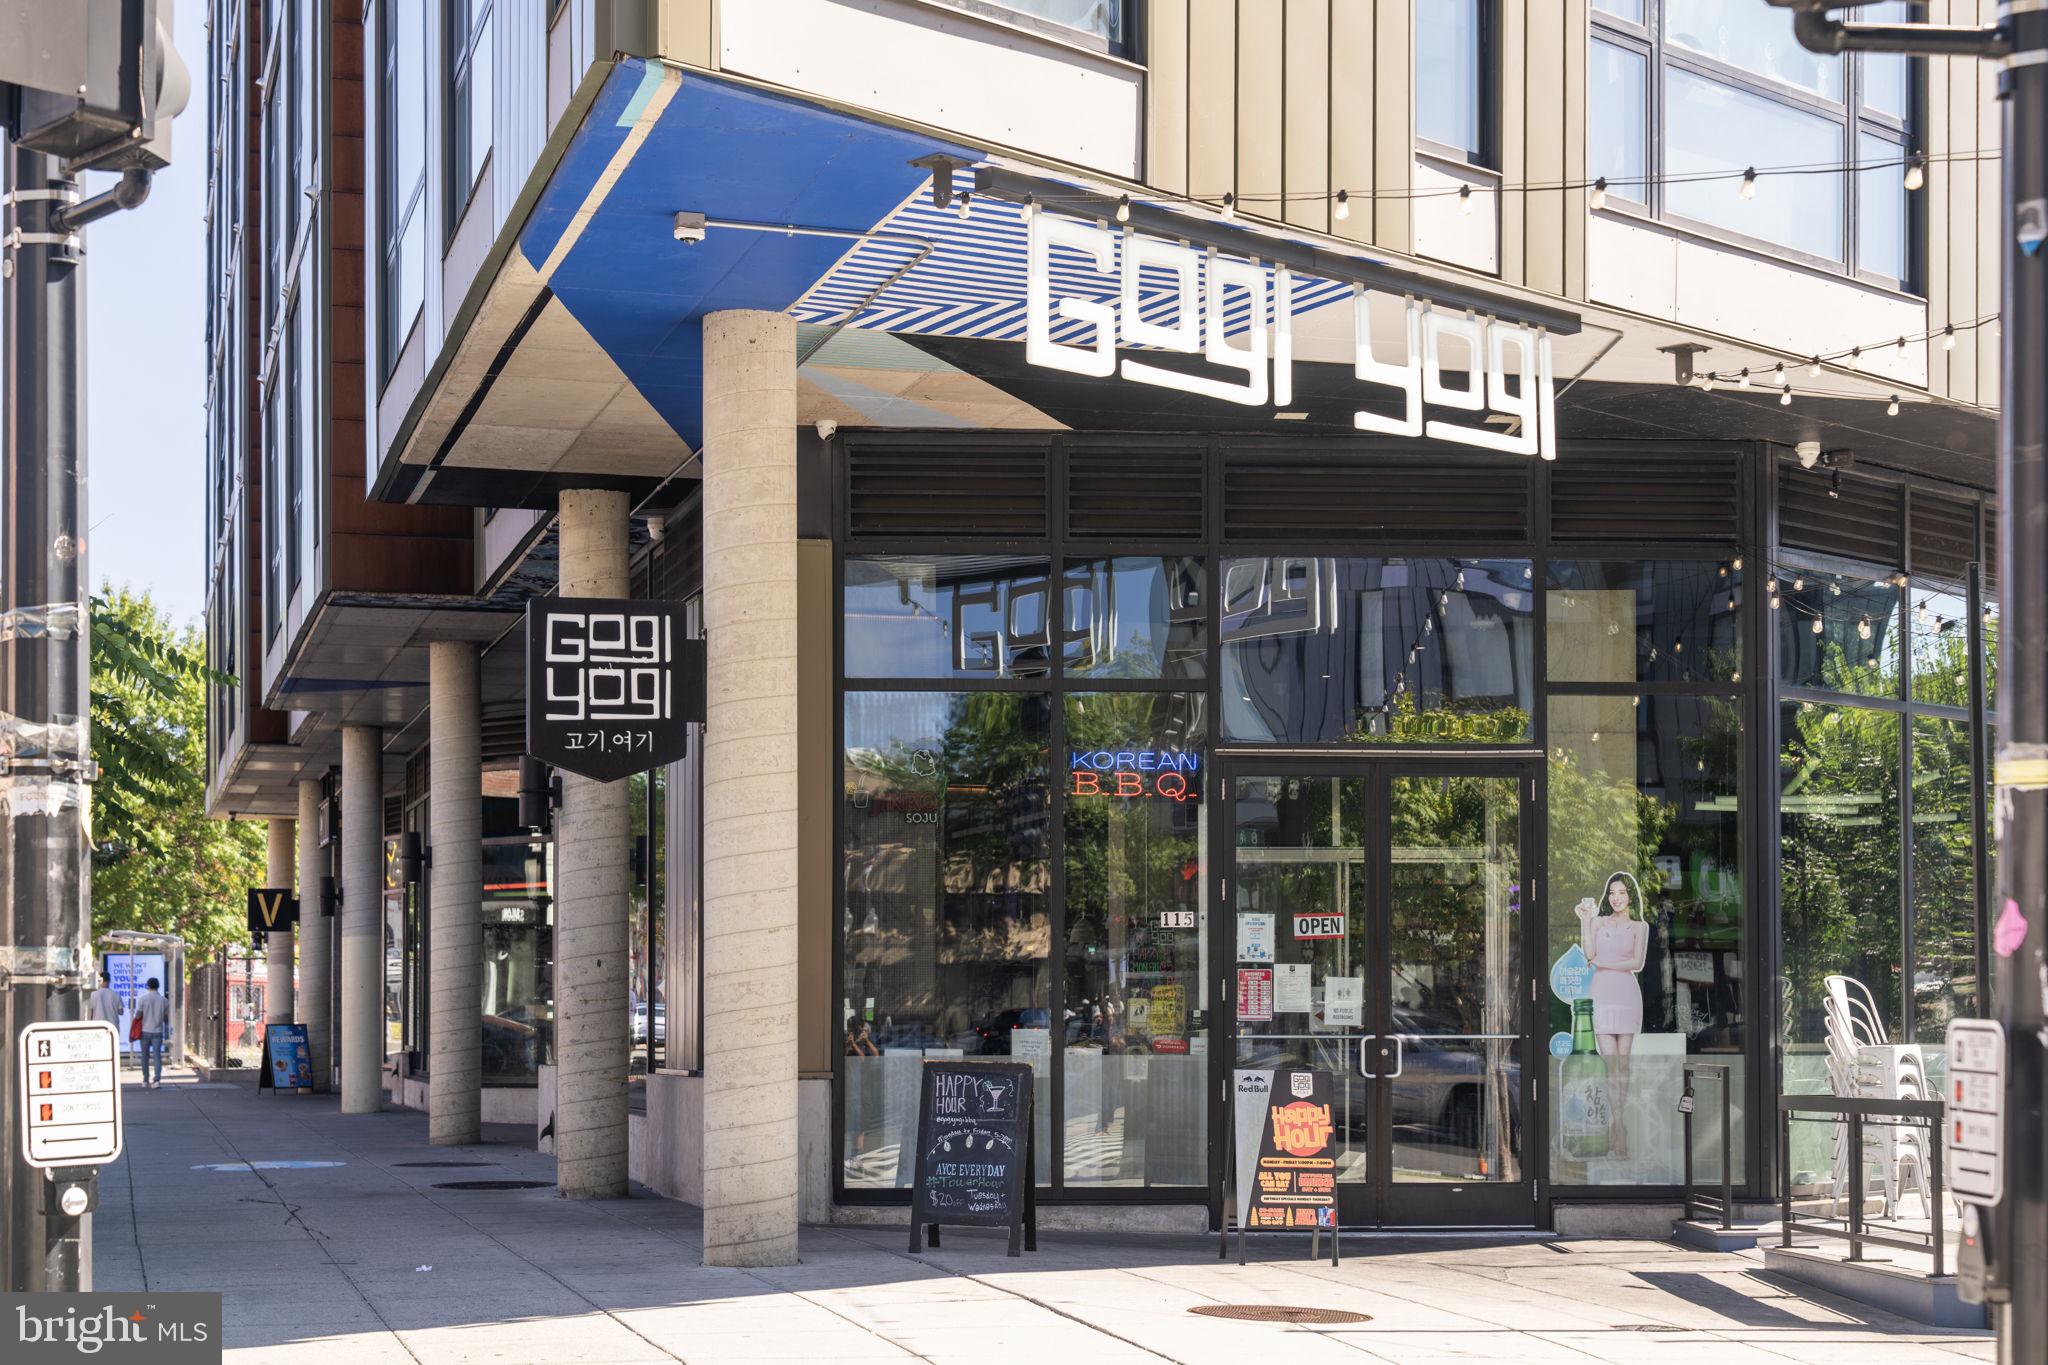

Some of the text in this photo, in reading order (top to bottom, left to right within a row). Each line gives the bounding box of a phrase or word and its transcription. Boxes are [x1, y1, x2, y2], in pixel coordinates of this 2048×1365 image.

[1071, 751, 1197, 771] KOREAN
[1071, 771, 1197, 801] B.B.Q.
[905, 812, 937, 824] SOJU
[257, 893, 282, 927] V
[1163, 912, 1193, 926] 115
[1299, 917, 1340, 934] OPEN
[271, 1035, 305, 1043] REWARDS
[936, 1074, 983, 1097] HAPPY
[936, 1097, 966, 1114] HOUR
[1271, 1104, 1332, 1127] Happy
[1272, 1122, 1334, 1151] Hour
[935, 1163, 1006, 1177] AYCE EVERYDAY
[1258, 1171, 1292, 1181] ALL YOU
[930, 1189, 953, 1207] $20
[966, 1188, 1000, 1203] Tuesday
